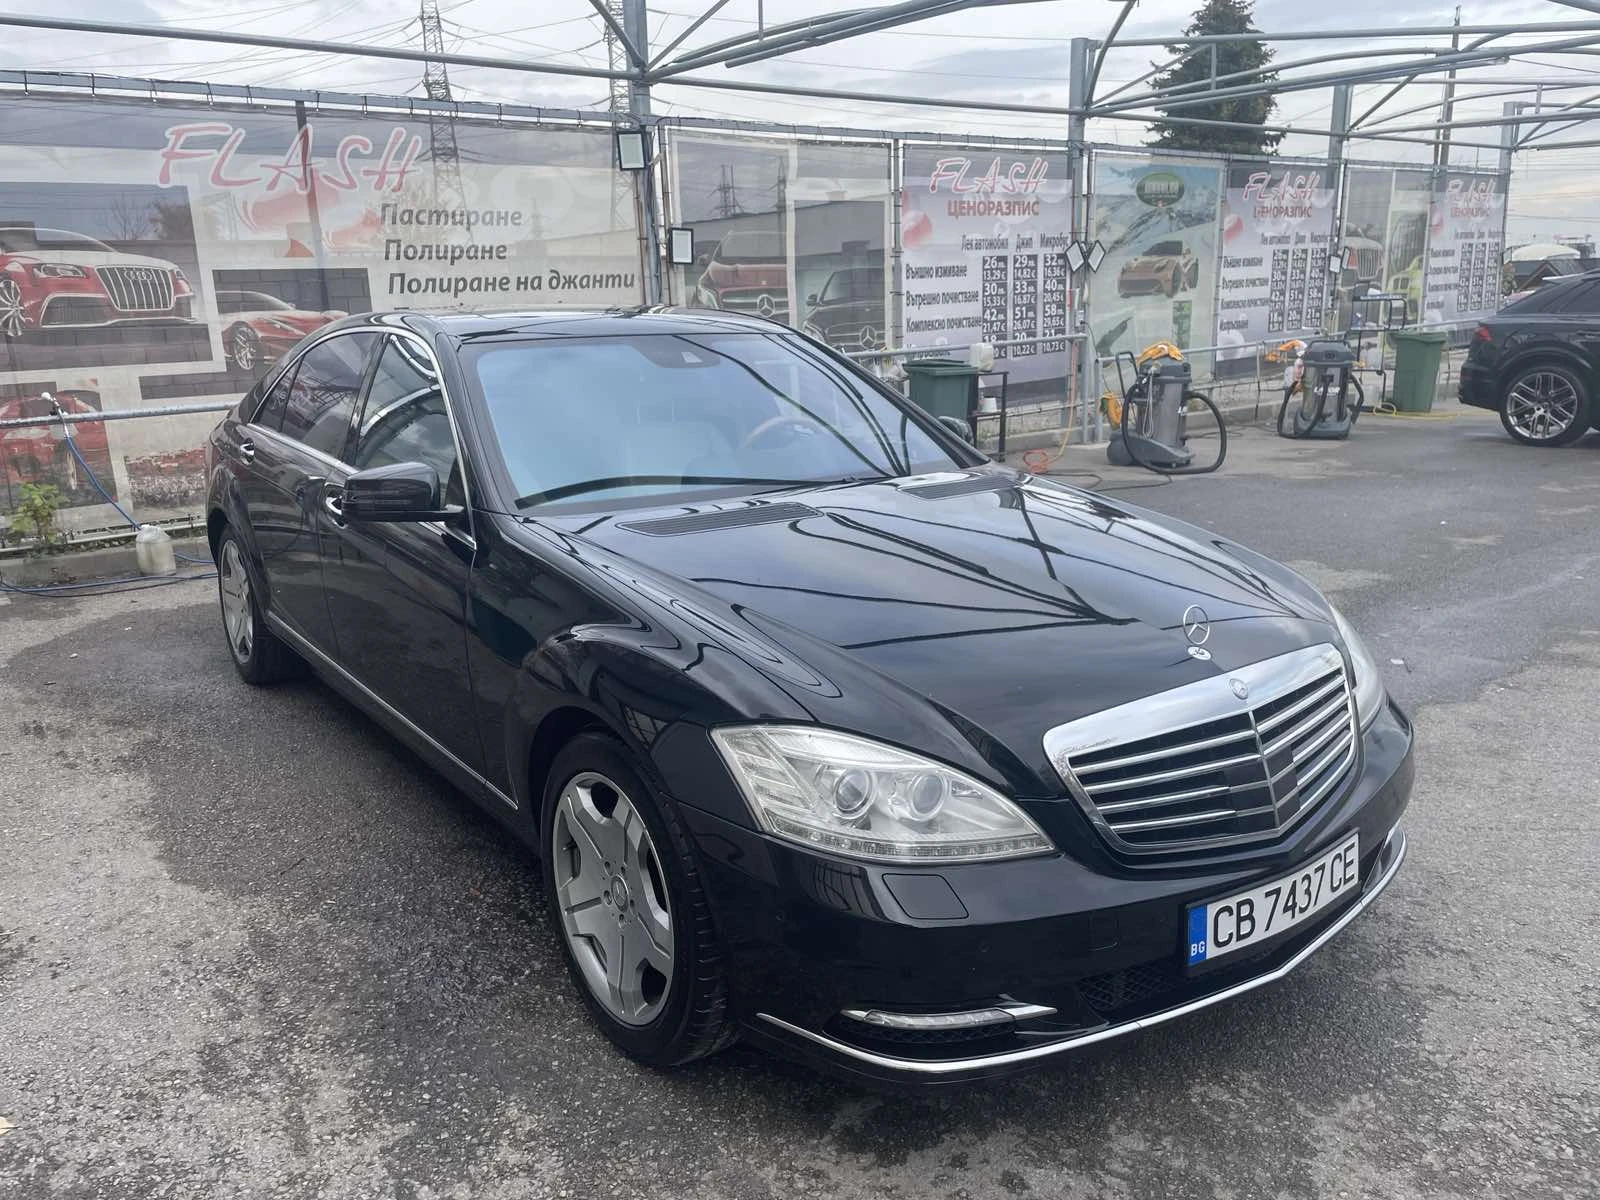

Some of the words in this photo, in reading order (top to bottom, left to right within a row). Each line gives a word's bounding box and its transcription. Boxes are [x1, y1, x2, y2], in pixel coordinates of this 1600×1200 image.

[159, 122, 423, 194] FLASH
[930, 157, 1048, 194] FLASH
[1242, 171, 1320, 201] FLASH
[947, 200, 1040, 220] ЦЕНОРАЗПИС
[381, 203, 522, 232] Пастиране
[385, 239, 508, 266] Полиране
[1045, 254, 1057, 265] 32
[984, 257, 997, 269] 26
[1016, 255, 1027, 267] 29
[388, 272, 511, 298] Полиране
[516, 275, 542, 291] на
[548, 270, 635, 291] джанти
[984, 282, 997, 295] 30
[1016, 281, 1027, 293] 33
[1045, 279, 1057, 290] 40
[983, 309, 997, 321] 42
[1015, 307, 1026, 319] 51
[1045, 304, 1057, 315] 58
[1213, 898, 1256, 948] CB
[1264, 862, 1326, 932] 7437
[1330, 842, 1356, 893] CE
[1191, 941, 1206, 957] BG
